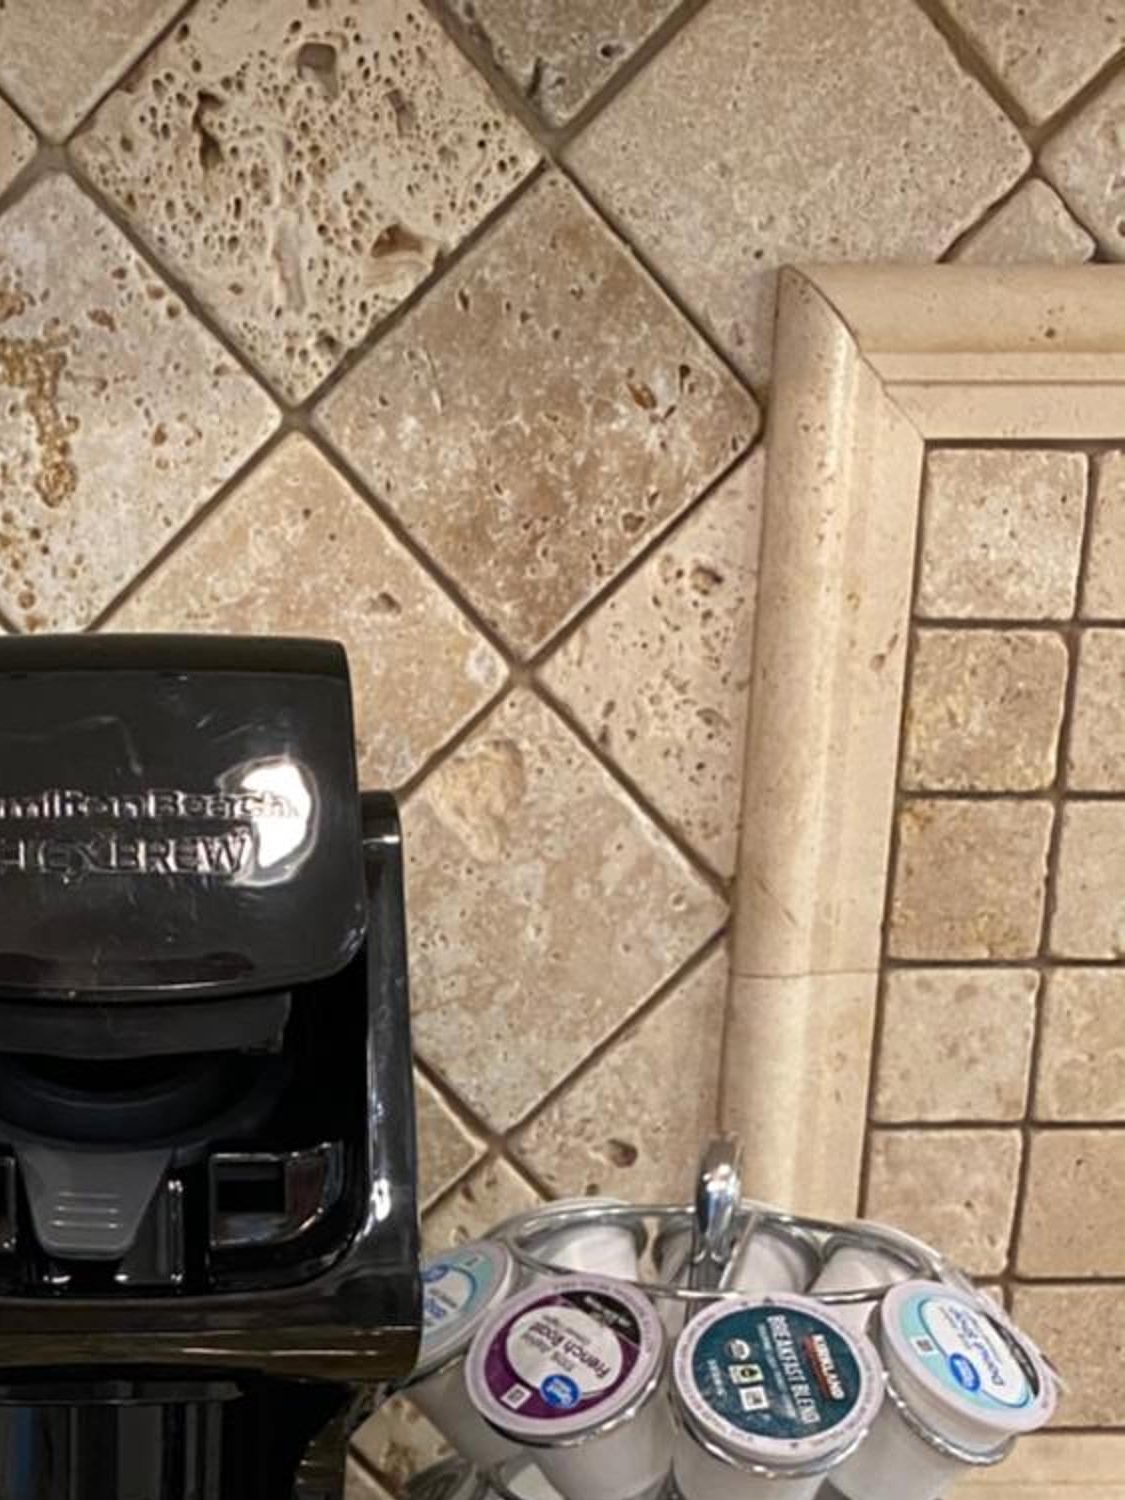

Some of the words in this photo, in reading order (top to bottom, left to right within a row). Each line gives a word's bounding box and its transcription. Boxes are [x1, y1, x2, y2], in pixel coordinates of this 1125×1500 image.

[564, 1341, 612, 1379] French
[767, 1314, 807, 1384] BREAKFAST
[791, 1383, 821, 1425] BLEND
[811, 1333, 846, 1400] KIRKLAND
